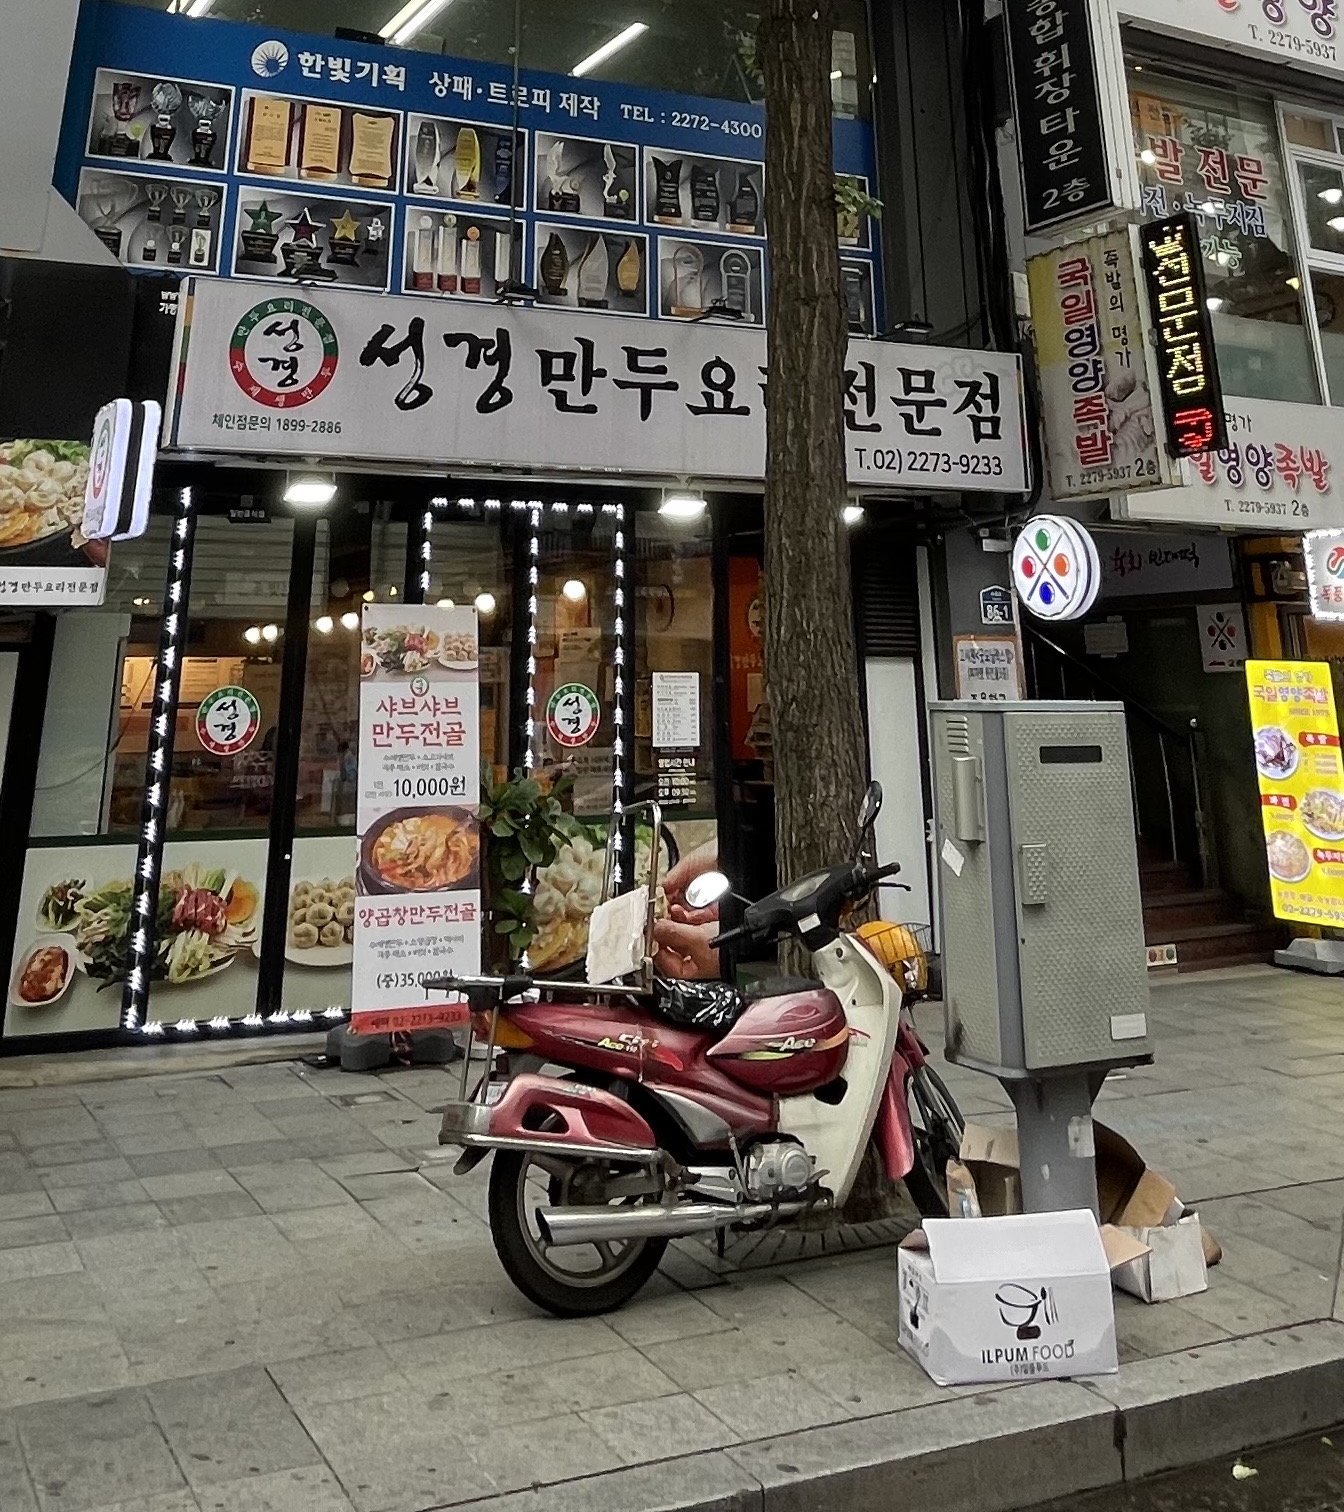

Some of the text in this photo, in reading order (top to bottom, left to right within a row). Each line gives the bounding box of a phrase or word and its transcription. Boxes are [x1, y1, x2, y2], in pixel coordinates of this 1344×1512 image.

[1268, 29, 1338, 61] 2279-5937
[297, 49, 407, 91] 한빛기획
[559, 93, 601, 122] 제작
[620, 104, 655, 125] TEL
[670, 109, 763, 141] 2272-4300
[1194, 145, 1270, 200] 전문
[1042, 177, 1092, 210] 2층
[1103, 249, 1131, 368] 족발의 명가
[258, 319, 305, 388] 성경
[1057, 257, 1113, 468] 국일영양족발
[359, 315, 1004, 443] 성경 만두요전문점
[211, 413, 343, 434] 체인점문의 1899-2886
[907, 448, 1005, 478] 2273-9233
[1080, 467, 1132, 483] 2279-5937
[1135, 457, 1157, 476] 2층
[1238, 500, 1287, 516] 2279-5937
[1292, 499, 1310, 517] 2층
[375, 695, 462, 719] 샤브샤브
[1253, 685, 1329, 704] 국일영양족발
[372, 721, 467, 748] 만두전골
[393, 775, 467, 799] 10,000원
[358, 902, 477, 928] 양곱창만두전골
[981, 1339, 1075, 1364] ILPUM FOOD
